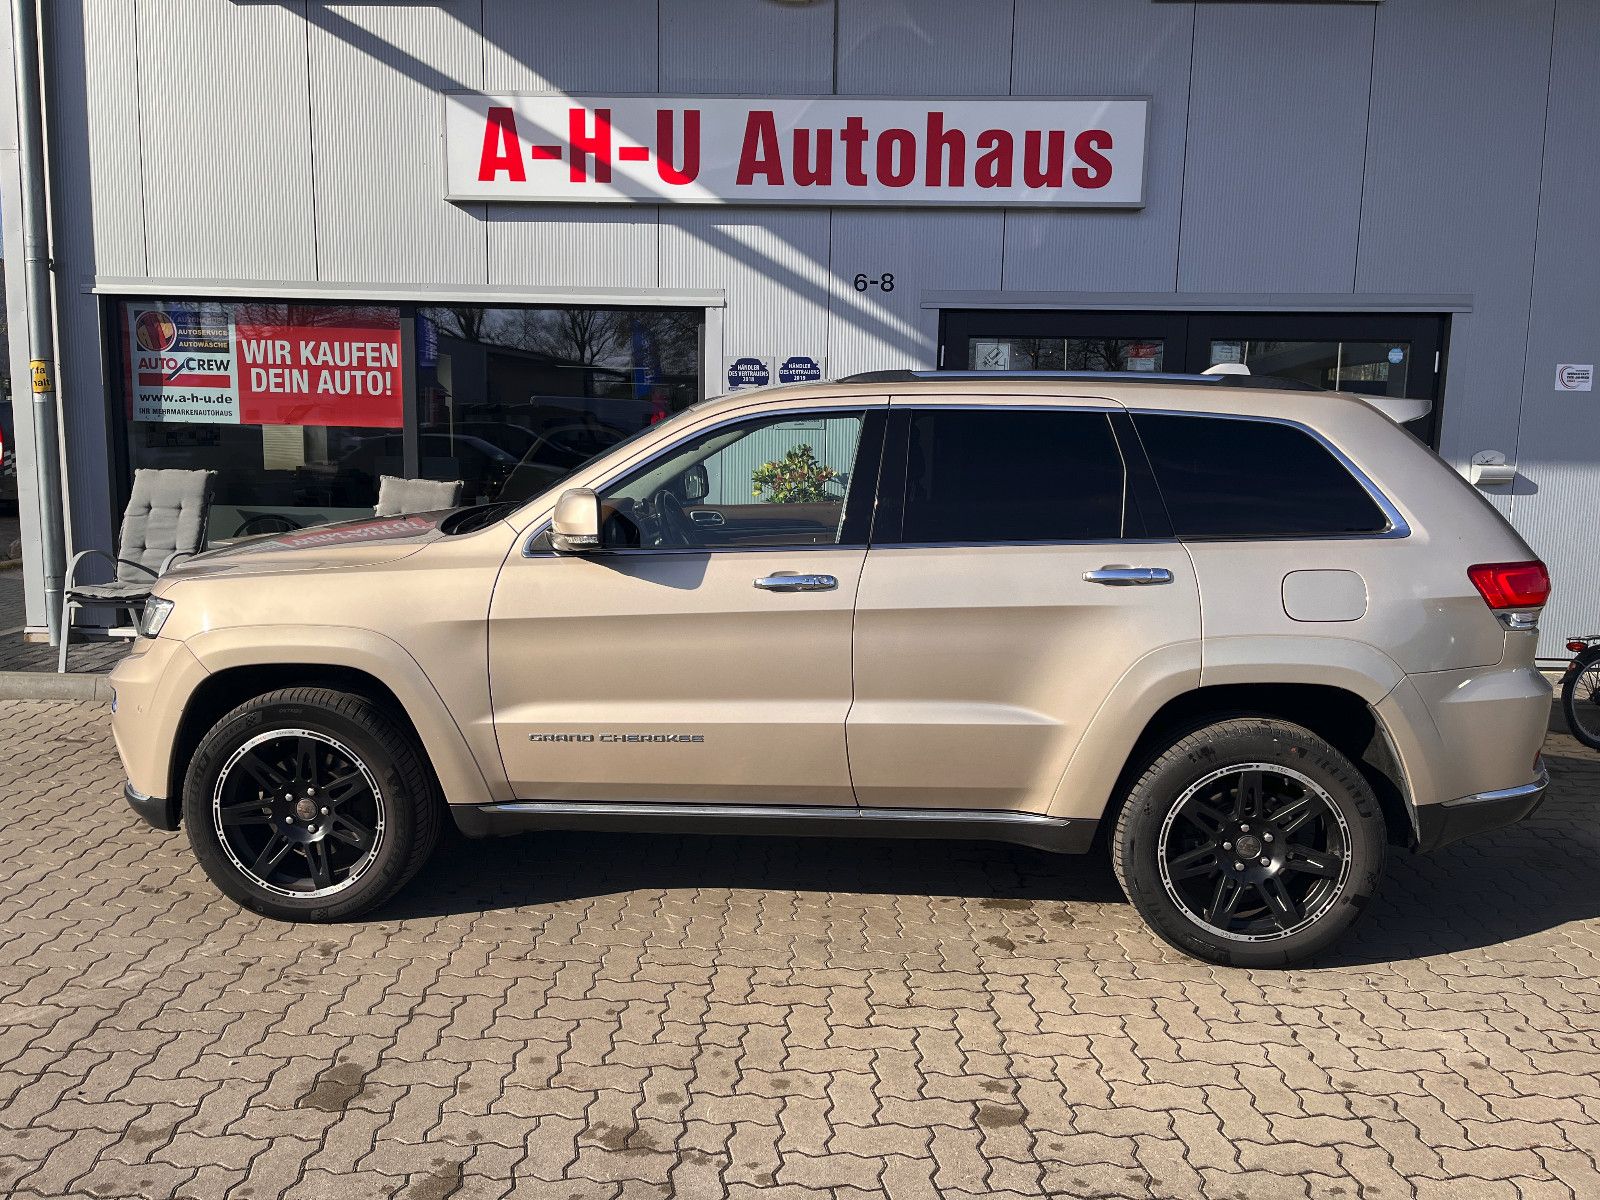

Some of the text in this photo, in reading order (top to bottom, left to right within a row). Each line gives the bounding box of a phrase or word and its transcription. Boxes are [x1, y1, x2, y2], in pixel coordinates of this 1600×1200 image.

[477, 106, 1114, 190] A-H-U Autohaus
[853, 272, 895, 293] 6-8
[178, 329, 229, 337] AUTOSERVICE
[241, 338, 399, 368] WIR KAUFEN
[250, 367, 392, 396] DEIN AUTO!
[139, 393, 233, 404] www.a-h-u.de
[139, 407, 233, 417] IHR MEHRMARKENAUTOHAUS
[529, 733, 705, 743] GRAND CHEROKEE
